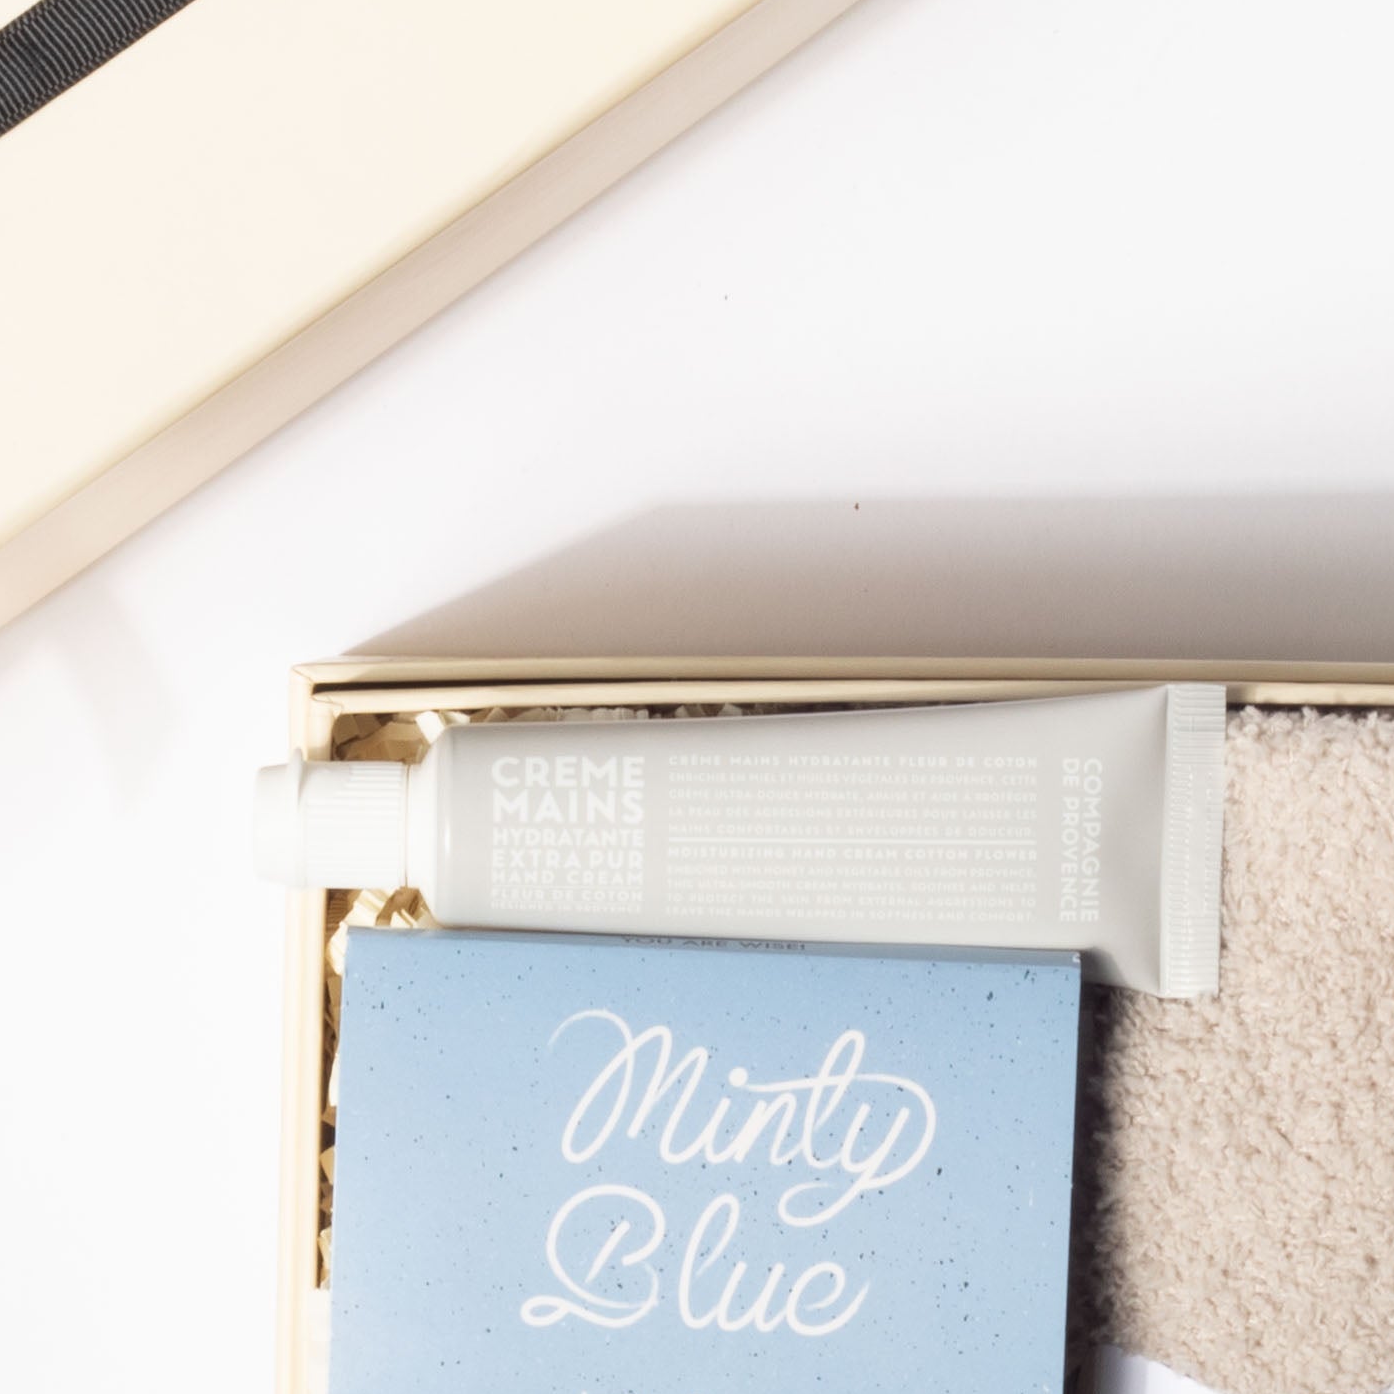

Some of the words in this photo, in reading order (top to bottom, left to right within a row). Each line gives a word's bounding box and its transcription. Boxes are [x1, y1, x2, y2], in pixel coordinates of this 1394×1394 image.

[491, 756, 645, 788] CREME
[729, 756, 781, 766] MAINS
[955, 756, 975, 767] DE
[983, 756, 1037, 767] COTON
[1061, 757, 1081, 788] DE
[492, 789, 645, 824] MAINS
[492, 828, 645, 848] HYDRATANTE
[1080, 757, 1103, 923] COMPAGNIE
[492, 848, 582, 869] EXTRA
[588, 849, 644, 869] PUR
[791, 847, 837, 860] HAND
[843, 848, 897, 860] CREAM
[903, 848, 969, 861] COTTON
[1059, 796, 1081, 923] PROVENCE
[491, 869, 555, 885] HAND
[566, 870, 644, 886] CREAM
[491, 888, 545, 900] FLEUR
[552, 890, 574, 901] DE
[582, 891, 644, 902] COTON
[547, 1009, 937, 1227] Minty
[519, 1184, 870, 1336] Blue
